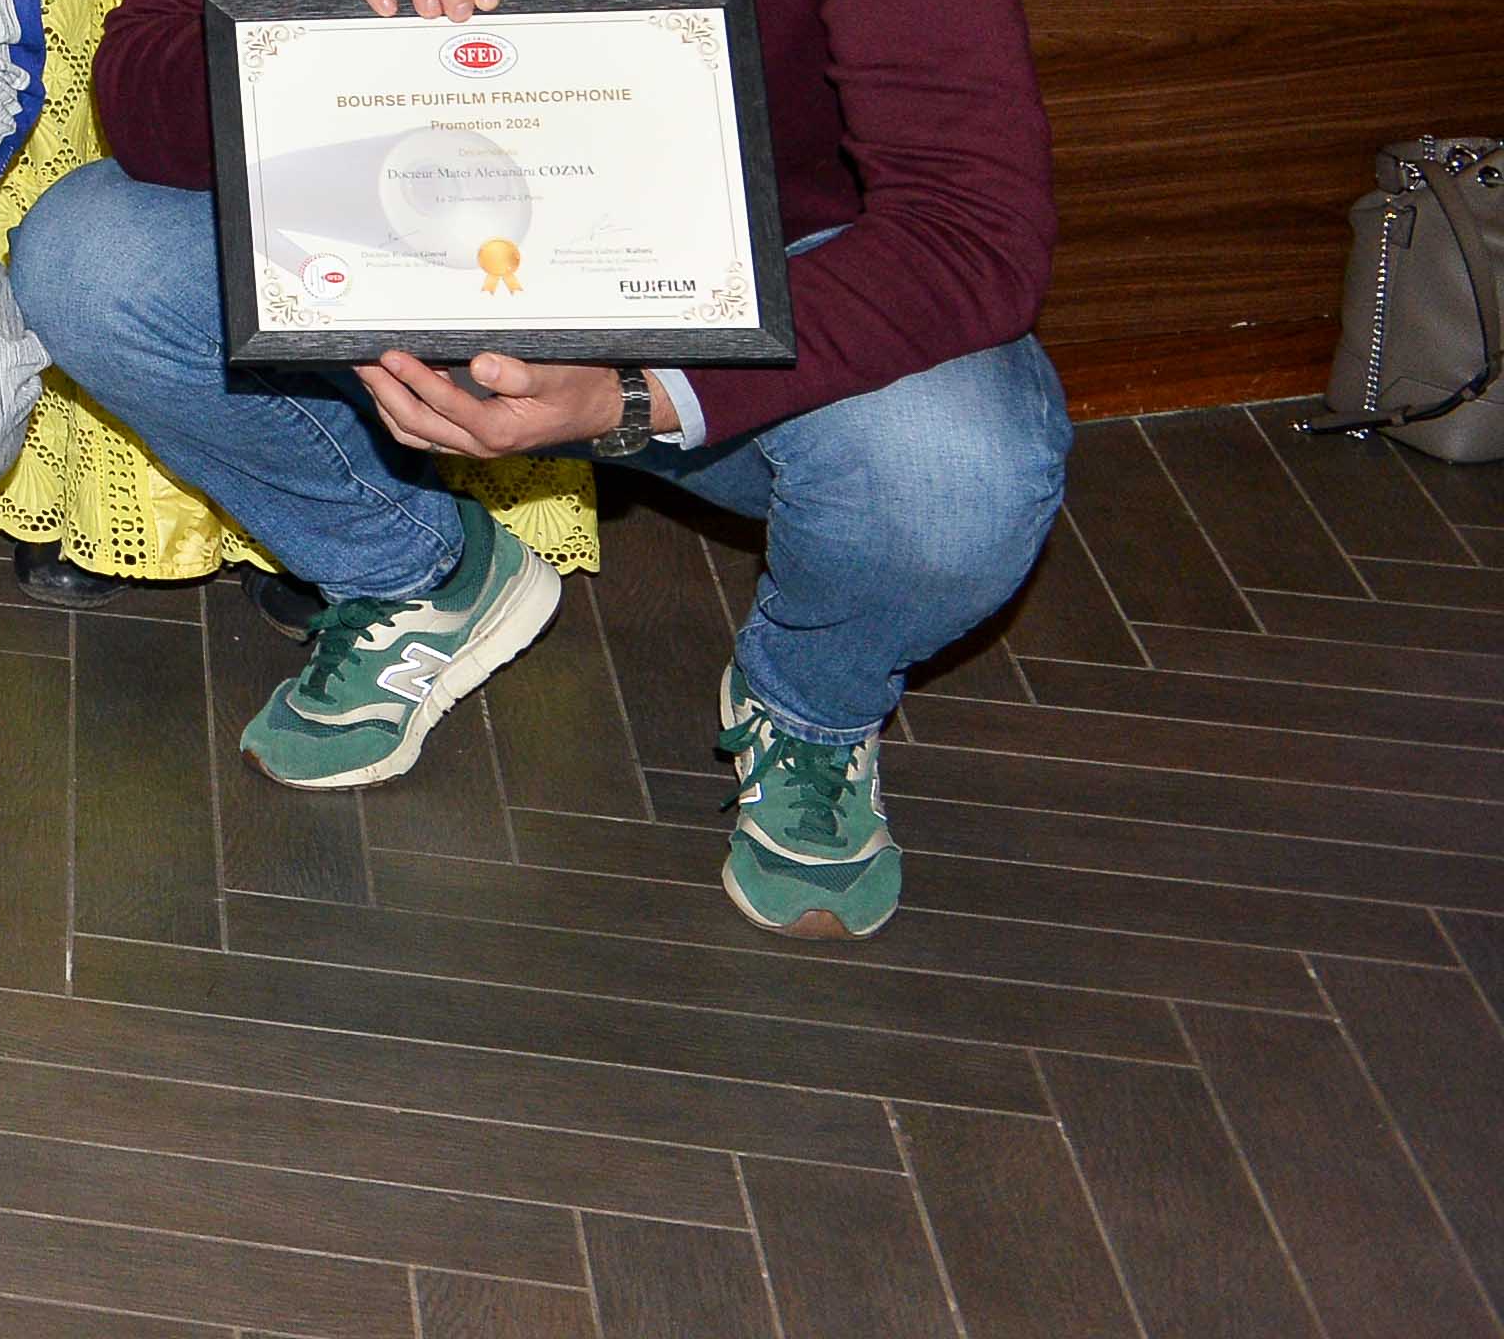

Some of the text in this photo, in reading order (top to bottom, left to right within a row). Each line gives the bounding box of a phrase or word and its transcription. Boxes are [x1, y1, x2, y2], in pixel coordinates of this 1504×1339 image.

[456, 48, 501, 63] SFED
[337, 88, 633, 108] BOURSE FUJIFILM FRANCOPHONIE
[431, 118, 541, 131] Promotion 2024
[387, 169, 433, 179] Docteur
[538, 165, 595, 176] COZMA
[619, 280, 696, 293] FUJIFILM
